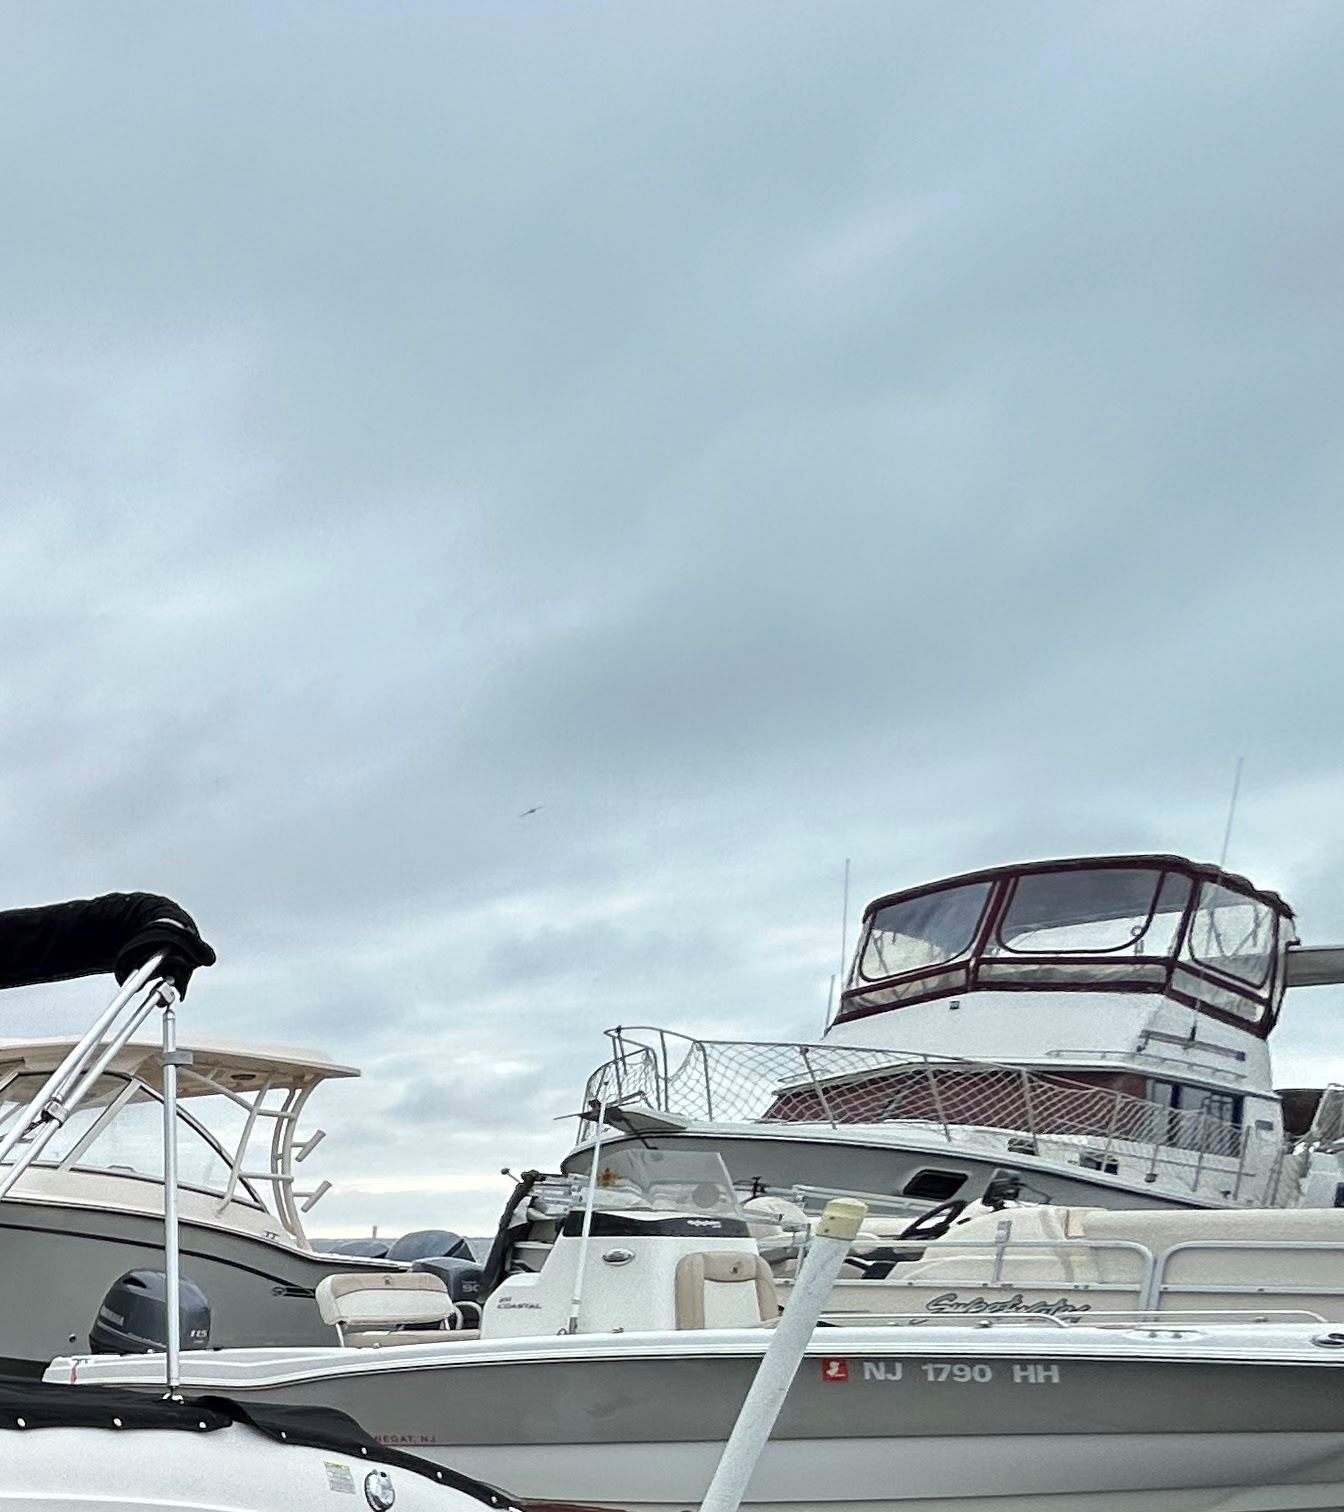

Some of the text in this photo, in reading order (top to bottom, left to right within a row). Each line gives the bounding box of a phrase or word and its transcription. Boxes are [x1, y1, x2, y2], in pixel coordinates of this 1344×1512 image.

[863, 1361, 1060, 1384] NJ 1790 HH
